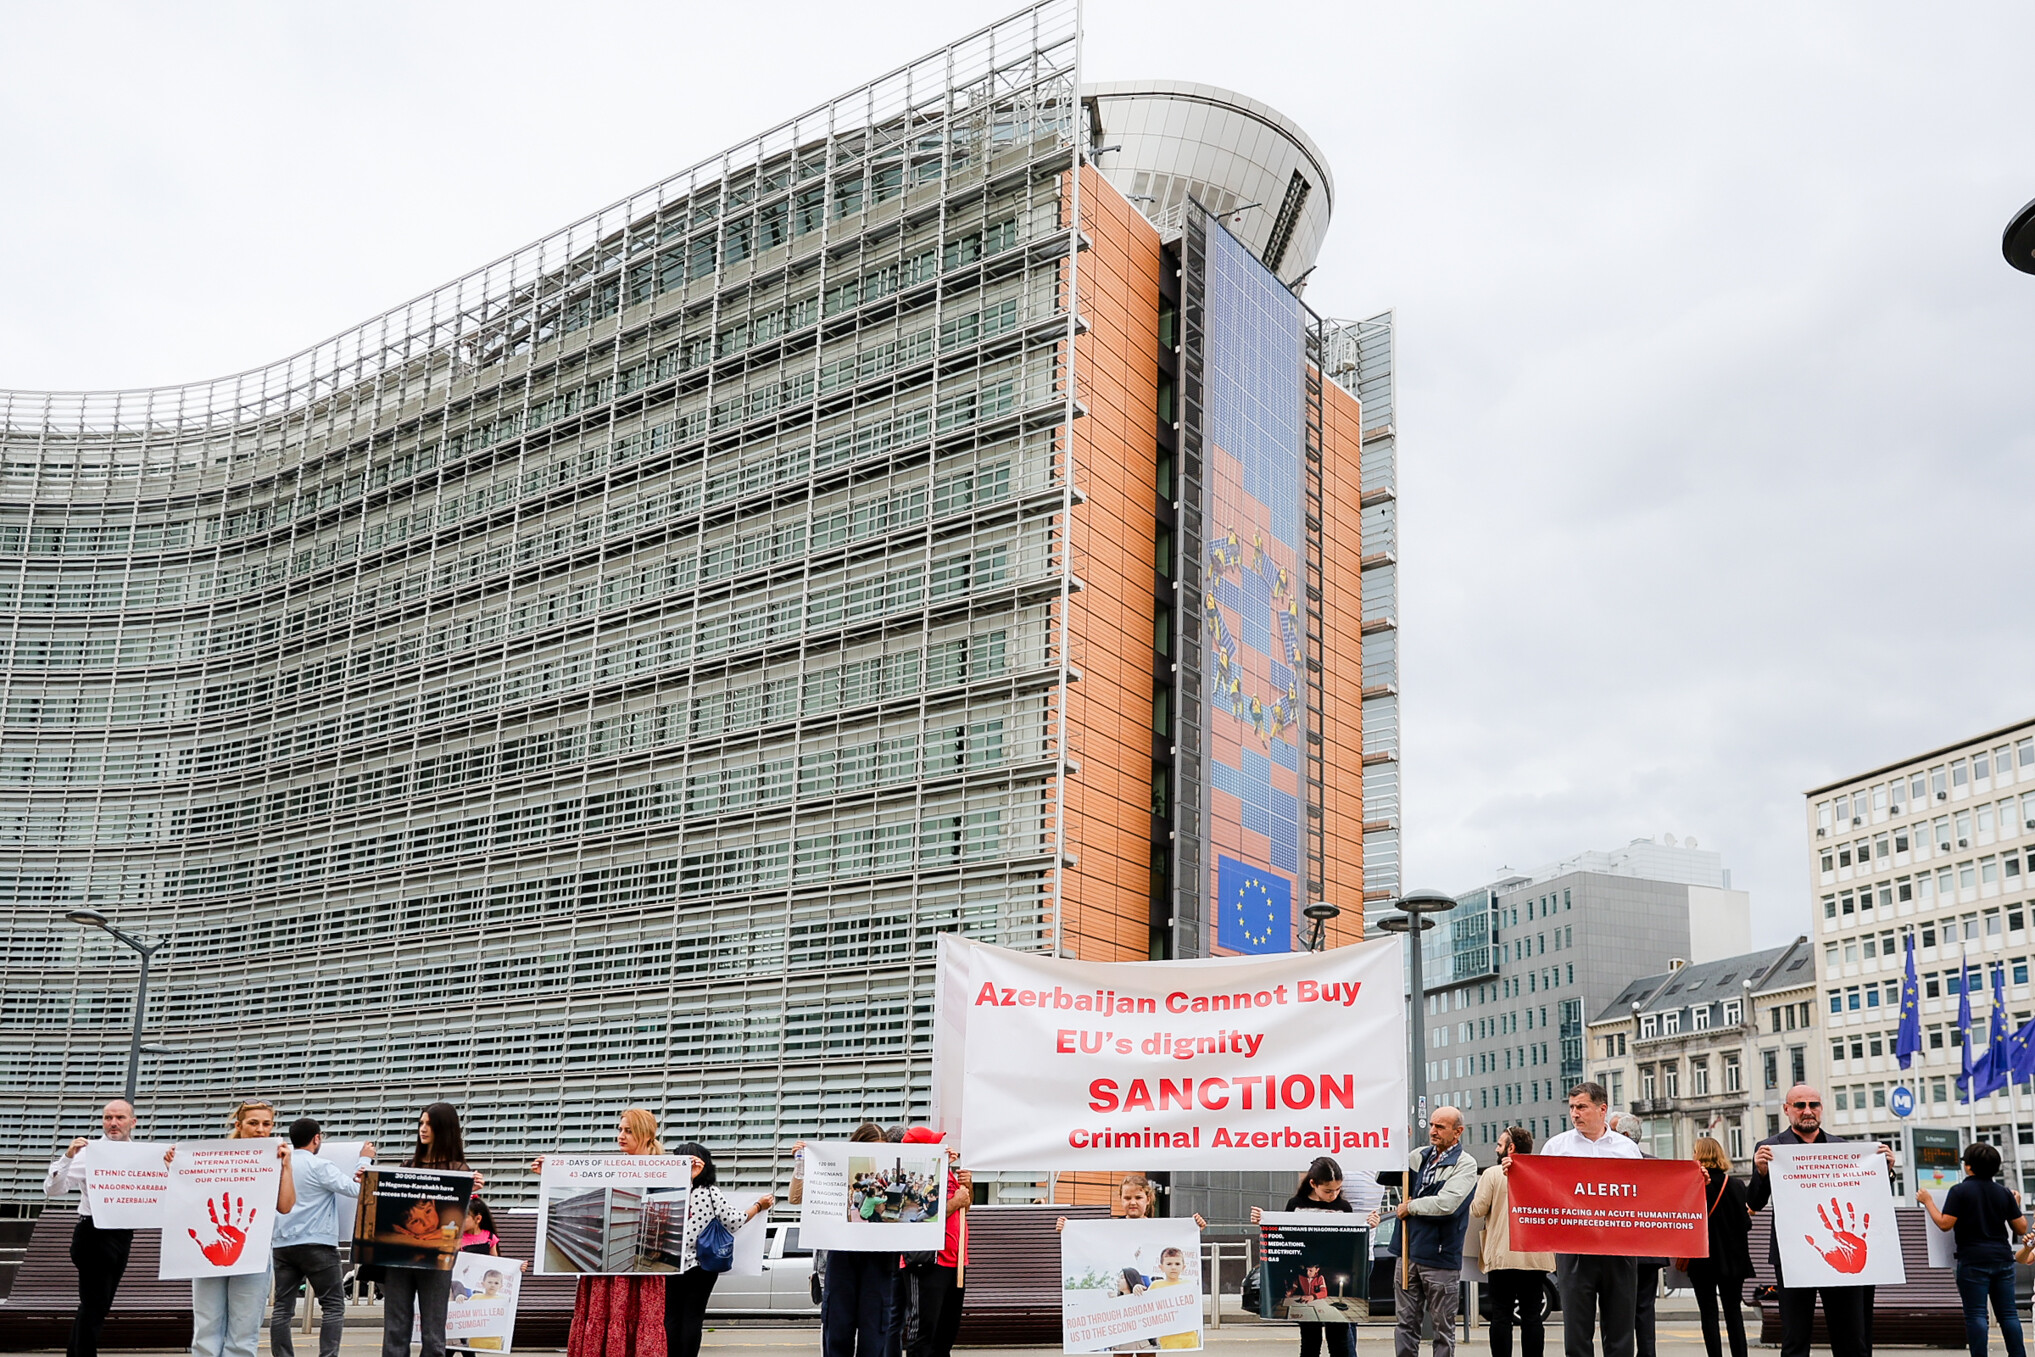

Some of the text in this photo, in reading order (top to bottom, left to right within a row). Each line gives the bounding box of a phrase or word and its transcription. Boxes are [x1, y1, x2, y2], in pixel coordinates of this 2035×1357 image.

[975, 980, 1361, 1017] Azerbaijan Cannot Buy
[1056, 1030, 1264, 1059] EU's dignity
[1088, 1073, 1355, 1113] SANCTION
[1894, 1095, 1911, 1108] M
[1068, 1126, 1390, 1154] Criminal Azerbaijan!
[1574, 1183, 1637, 1197] ALERT!
[1561, 1219, 1632, 1227] UNPRECEDENTED
[1634, 1221, 1694, 1229] PROPORTIONS
[1638, 1211, 1702, 1220] HUMANITARIAN
[473, 1309, 488, 1317] WILL
[1067, 1294, 1194, 1328] ROAD THROUGH AGHDAM WILL LEAD
[1070, 1331, 1080, 1342] US
[1081, 1330, 1090, 1340] TO
[1092, 1327, 1107, 1339] THE
[1108, 1322, 1137, 1335] SECOND
